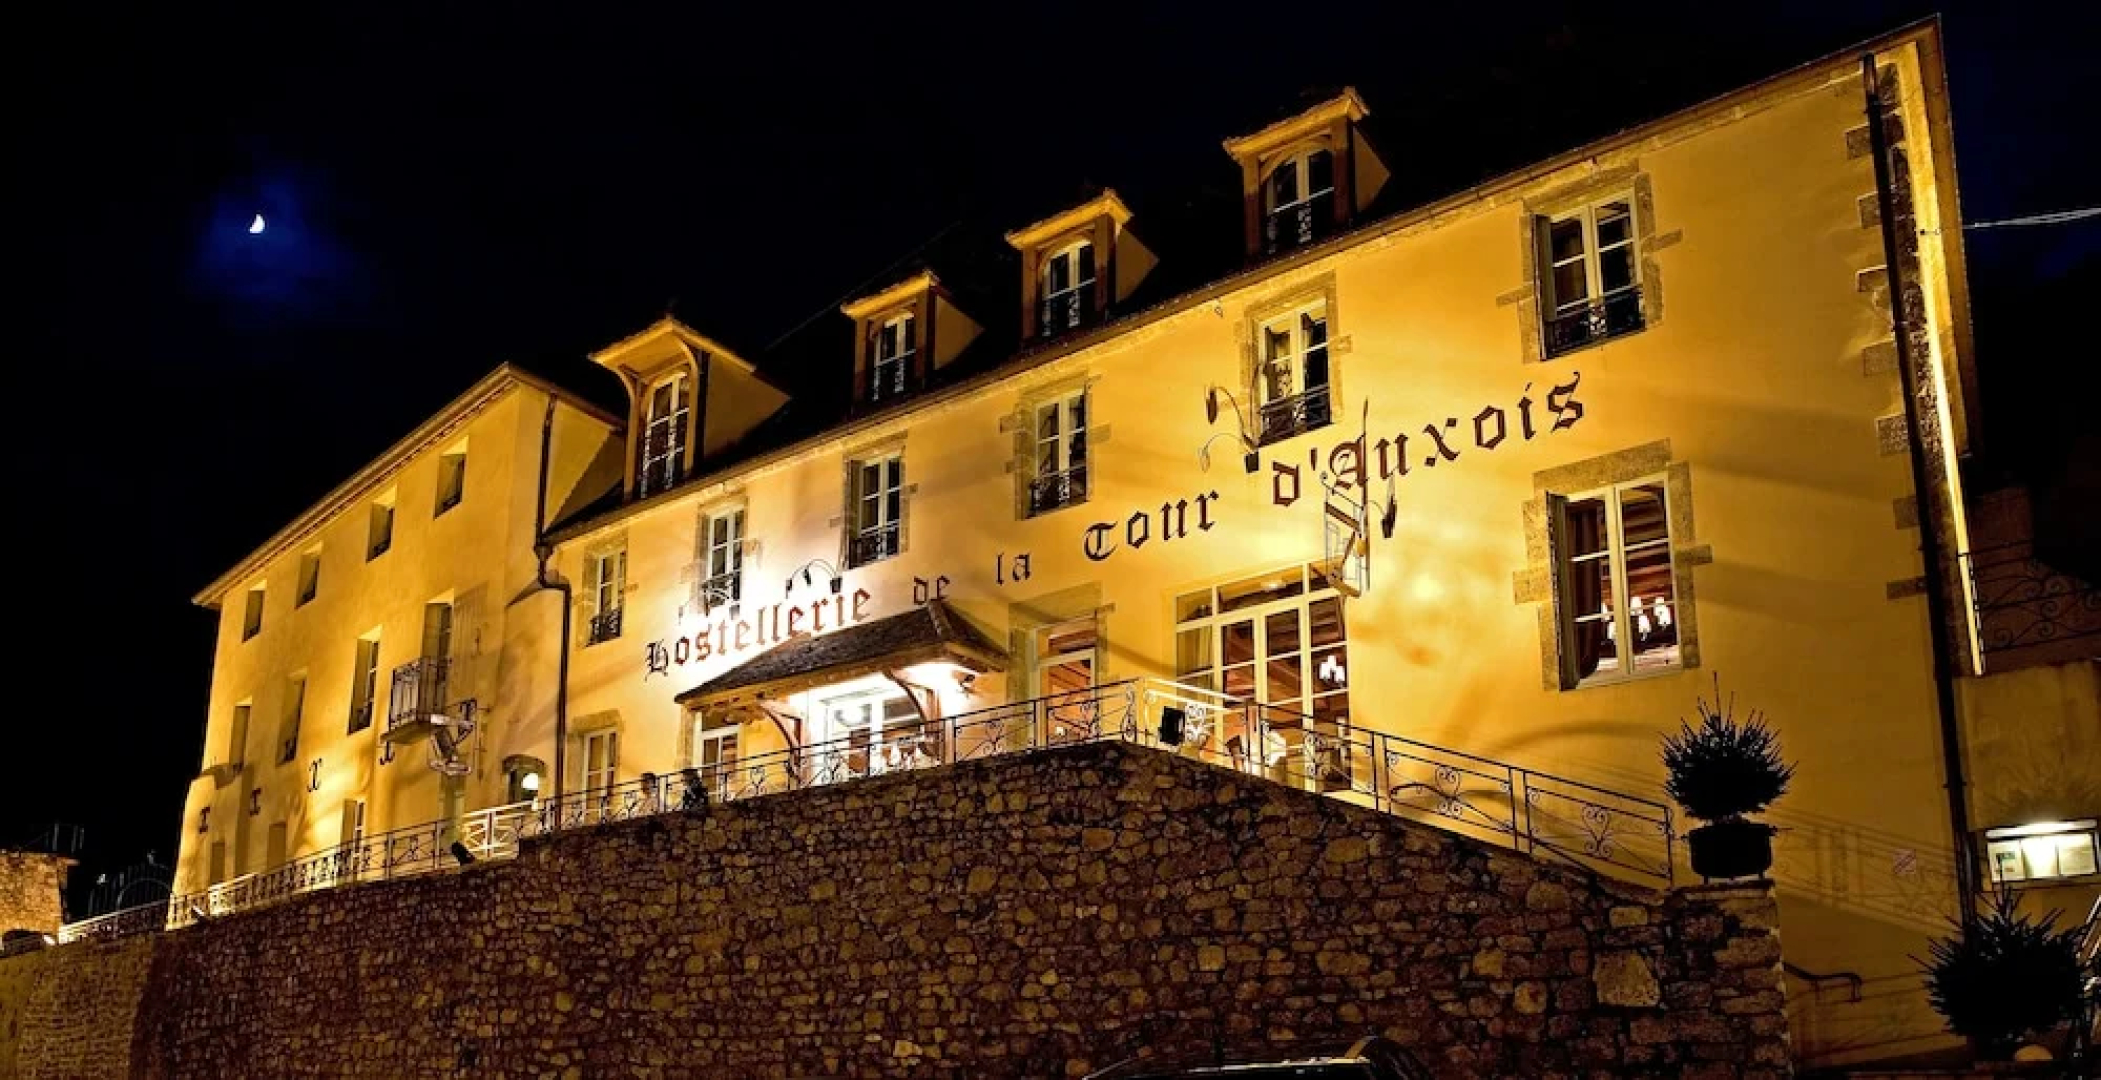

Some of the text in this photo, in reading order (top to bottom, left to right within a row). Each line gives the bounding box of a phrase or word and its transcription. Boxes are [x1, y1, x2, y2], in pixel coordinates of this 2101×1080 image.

[913, 574, 950, 606] de
[995, 551, 1031, 586] la
[1083, 489, 1220, 562] Tour
[1271, 370, 1584, 507] d'Auxois
